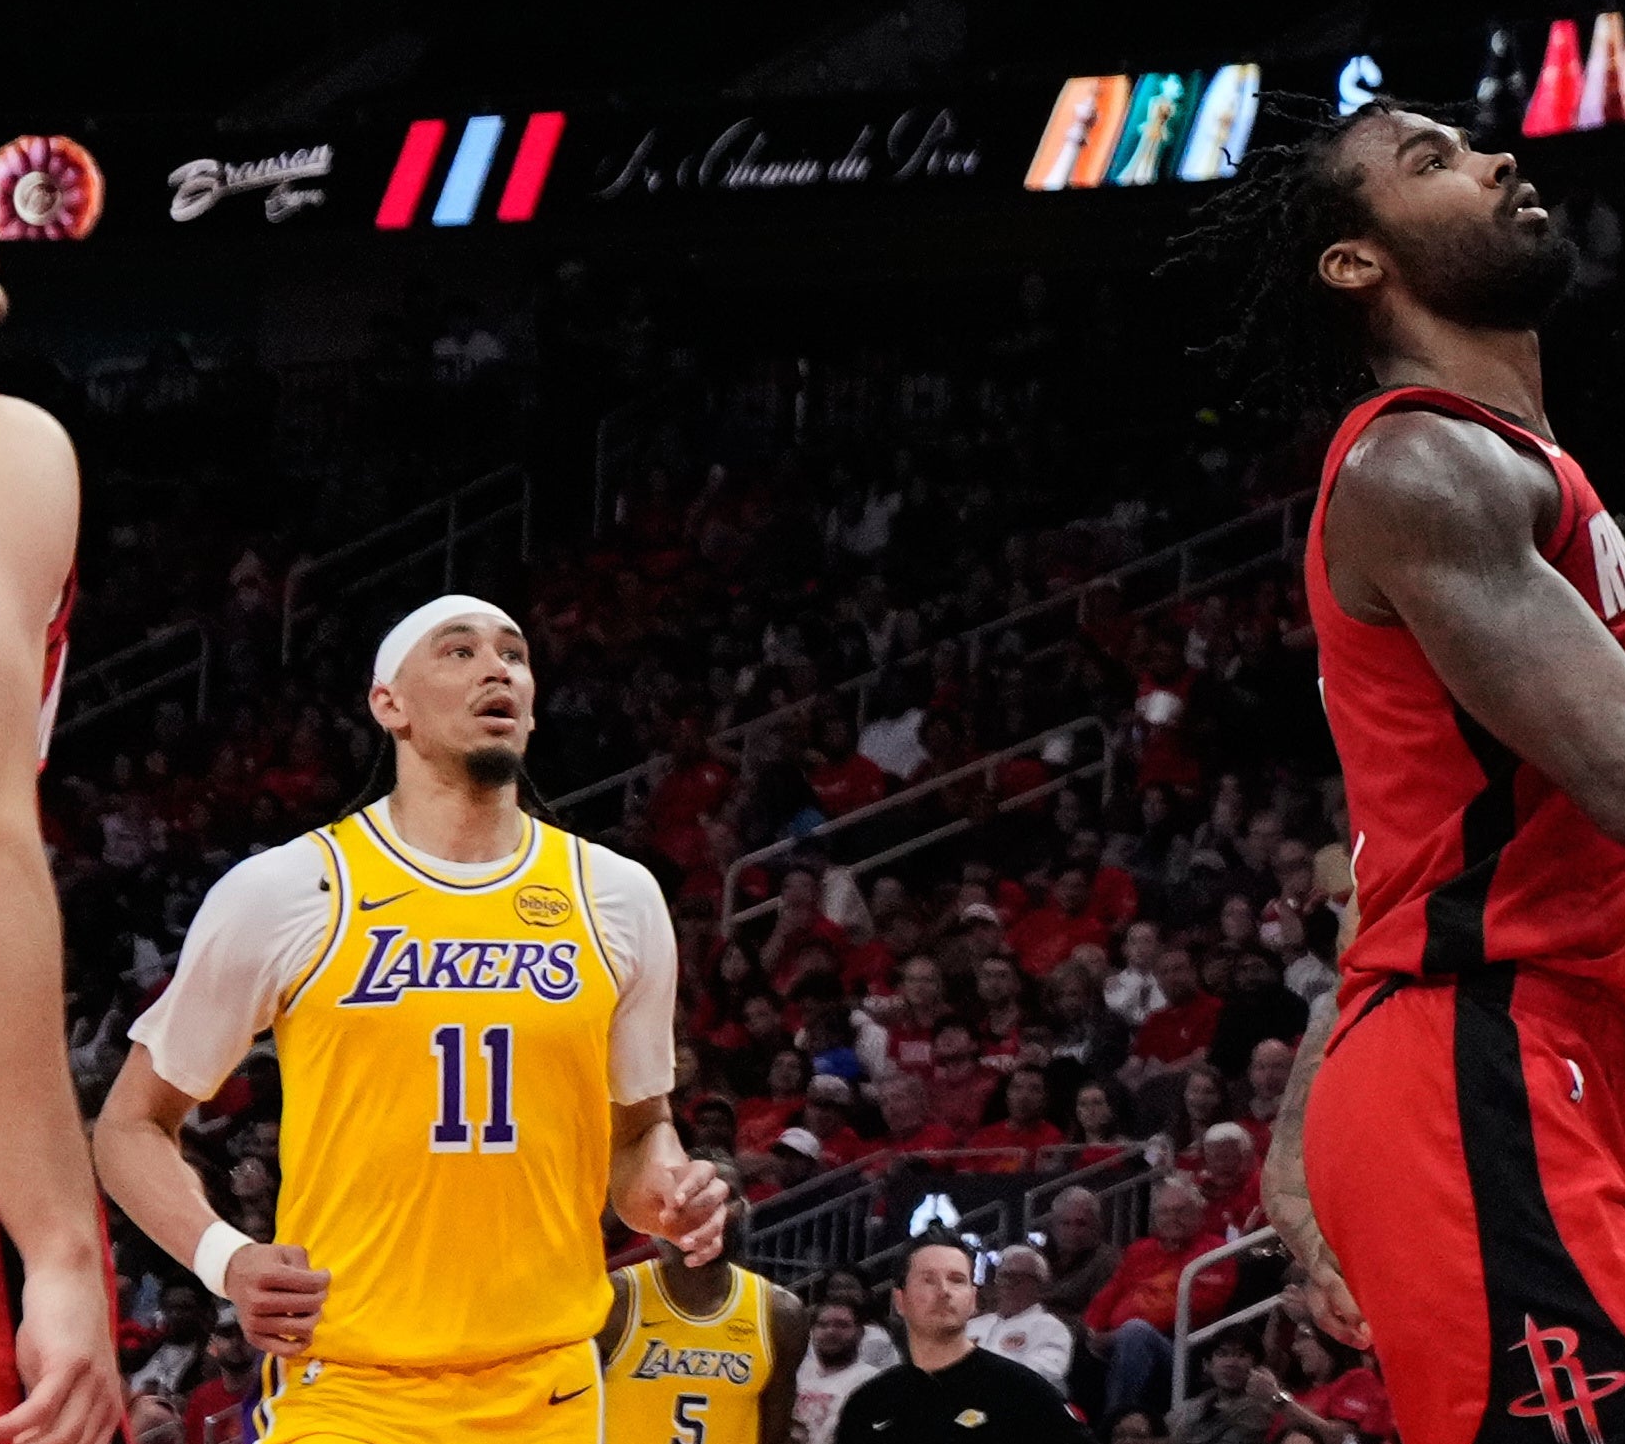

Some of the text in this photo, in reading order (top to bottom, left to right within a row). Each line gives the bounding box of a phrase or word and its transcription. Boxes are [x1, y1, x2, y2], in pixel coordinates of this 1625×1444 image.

[340, 926, 580, 1007] LAKERS
[429, 1024, 518, 1154] 11
[629, 1337, 754, 1386] LAKERS
